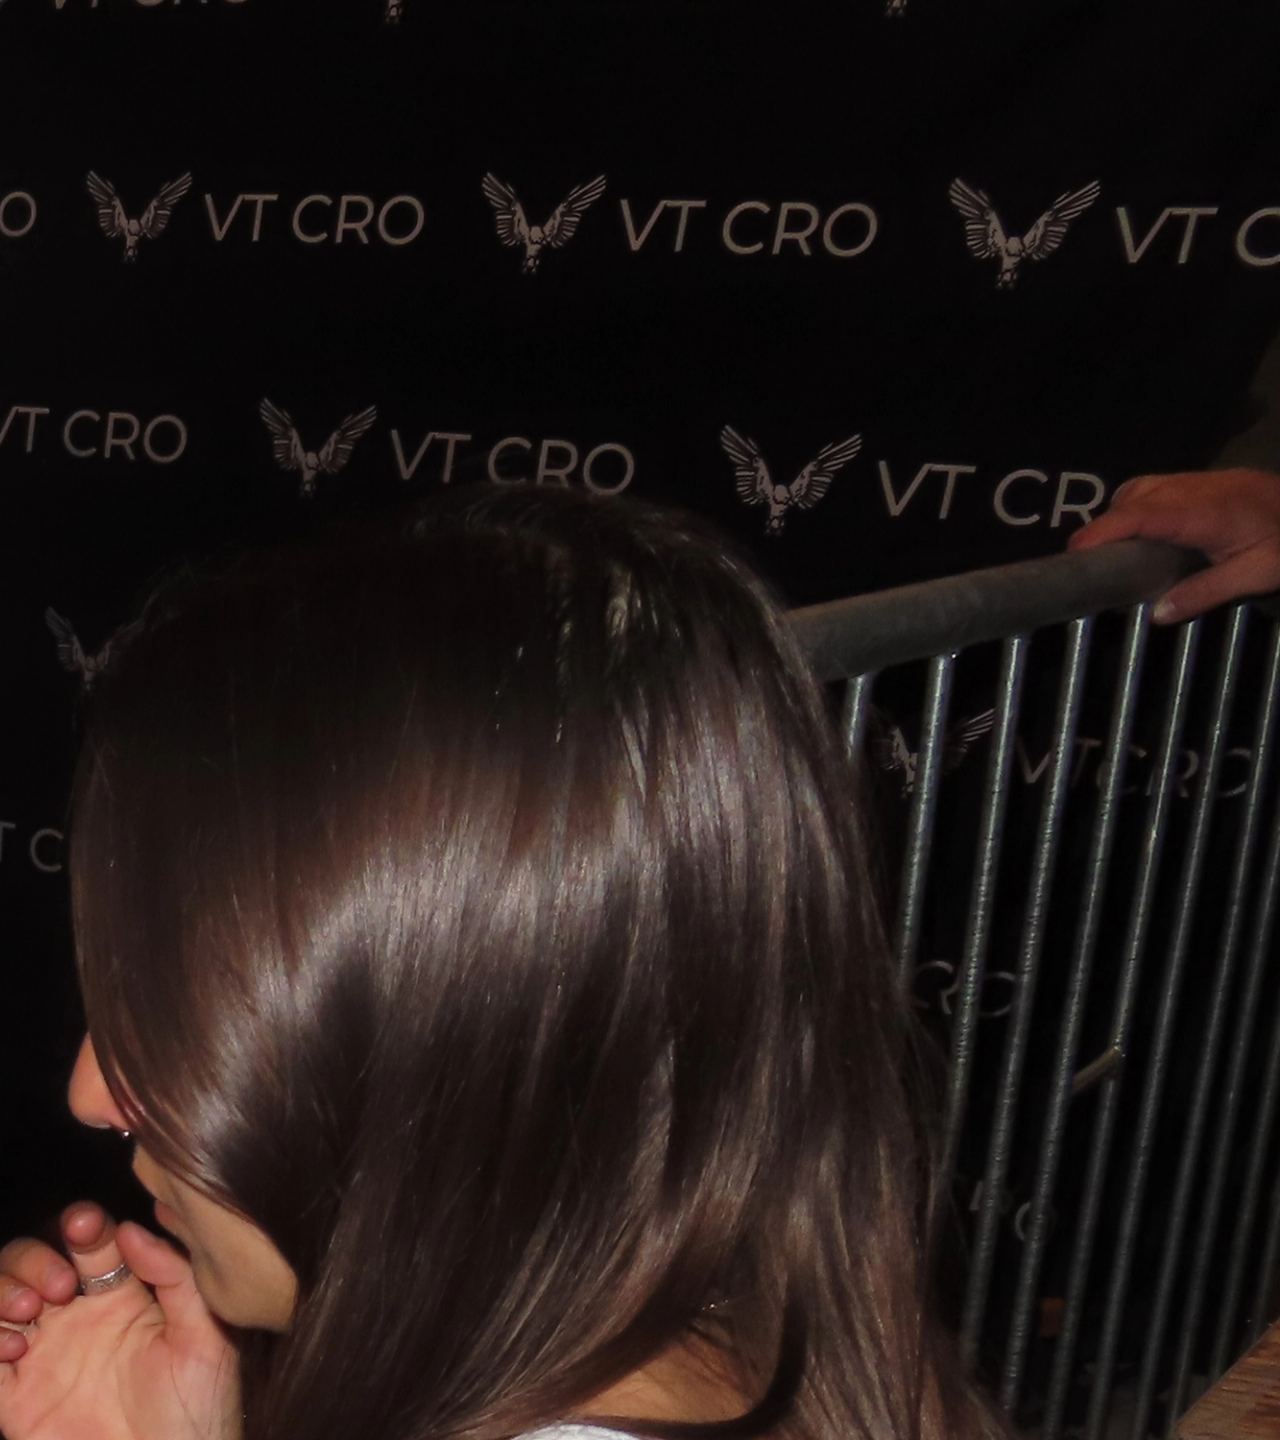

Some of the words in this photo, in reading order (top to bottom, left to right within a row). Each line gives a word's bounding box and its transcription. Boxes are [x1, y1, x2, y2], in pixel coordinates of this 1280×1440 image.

[204, 193, 279, 242] VT
[292, 194, 425, 245] CRO
[620, 199, 707, 252] VT
[723, 201, 878, 257] CRO
[1116, 206, 1219, 264] VT
[63, 410, 188, 463] CRO
[391, 429, 472, 484] VT
[487, 437, 635, 497] CRO
[878, 460, 977, 520] VT
[993, 469, 1106, 528] CR
